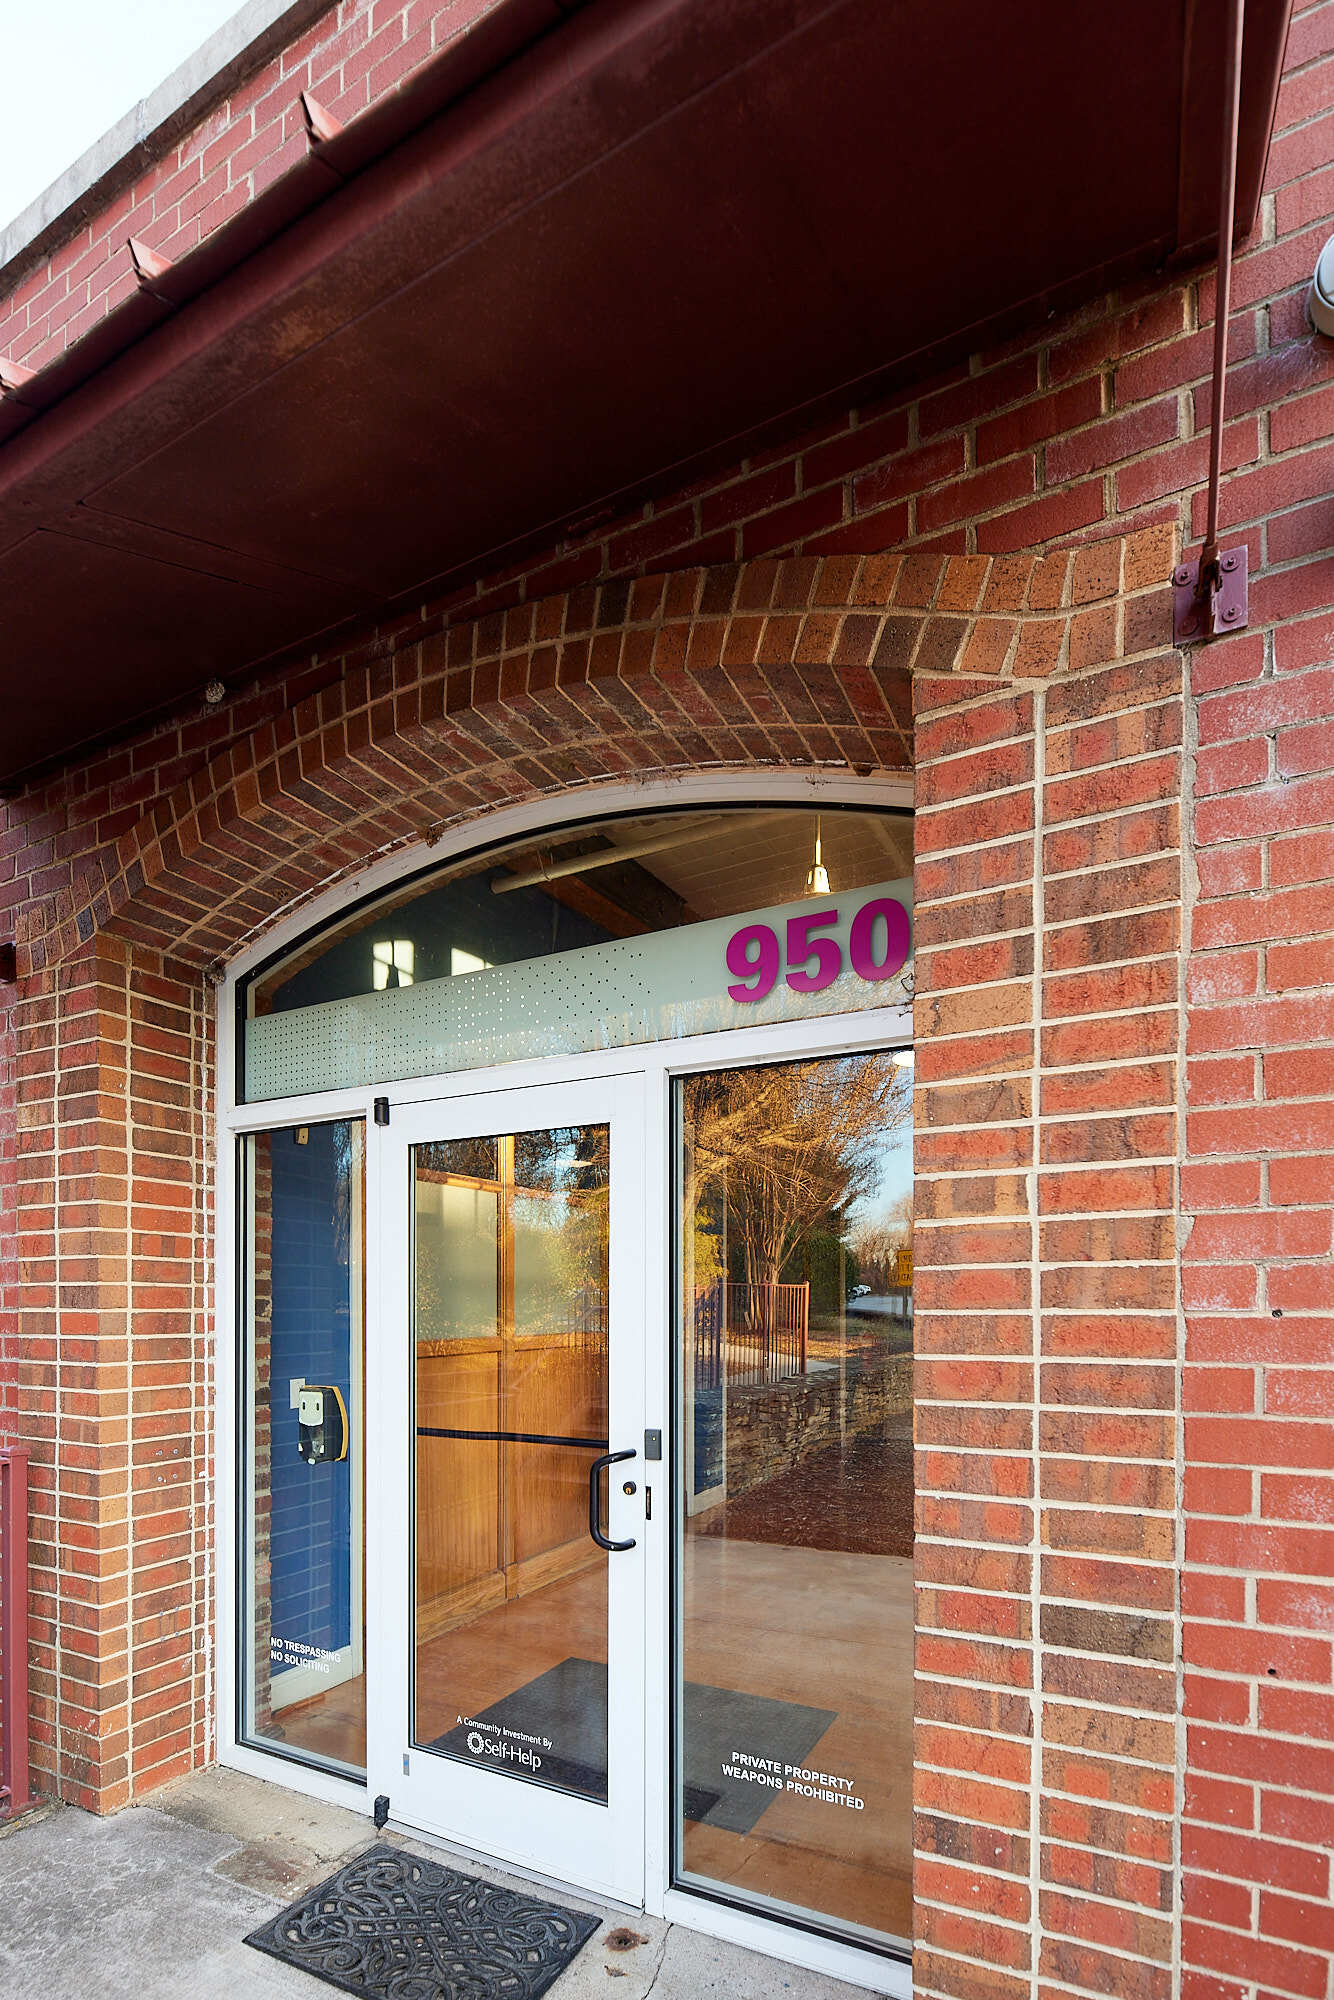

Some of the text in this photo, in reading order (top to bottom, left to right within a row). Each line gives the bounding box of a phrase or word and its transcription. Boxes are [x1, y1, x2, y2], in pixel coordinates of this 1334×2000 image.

[726, 898, 910, 1003] 950
[270, 1636, 341, 1663] NO TRESPASSING
[270, 1649, 330, 1674] NO SOLICITING
[456, 1715, 553, 1750] A Community Investment By
[484, 1738, 541, 1772] Self-Help
[731, 1751, 855, 1792] PRIVATE PROPERTY
[721, 1763, 865, 1810] WEAPONS PROHIBITED
